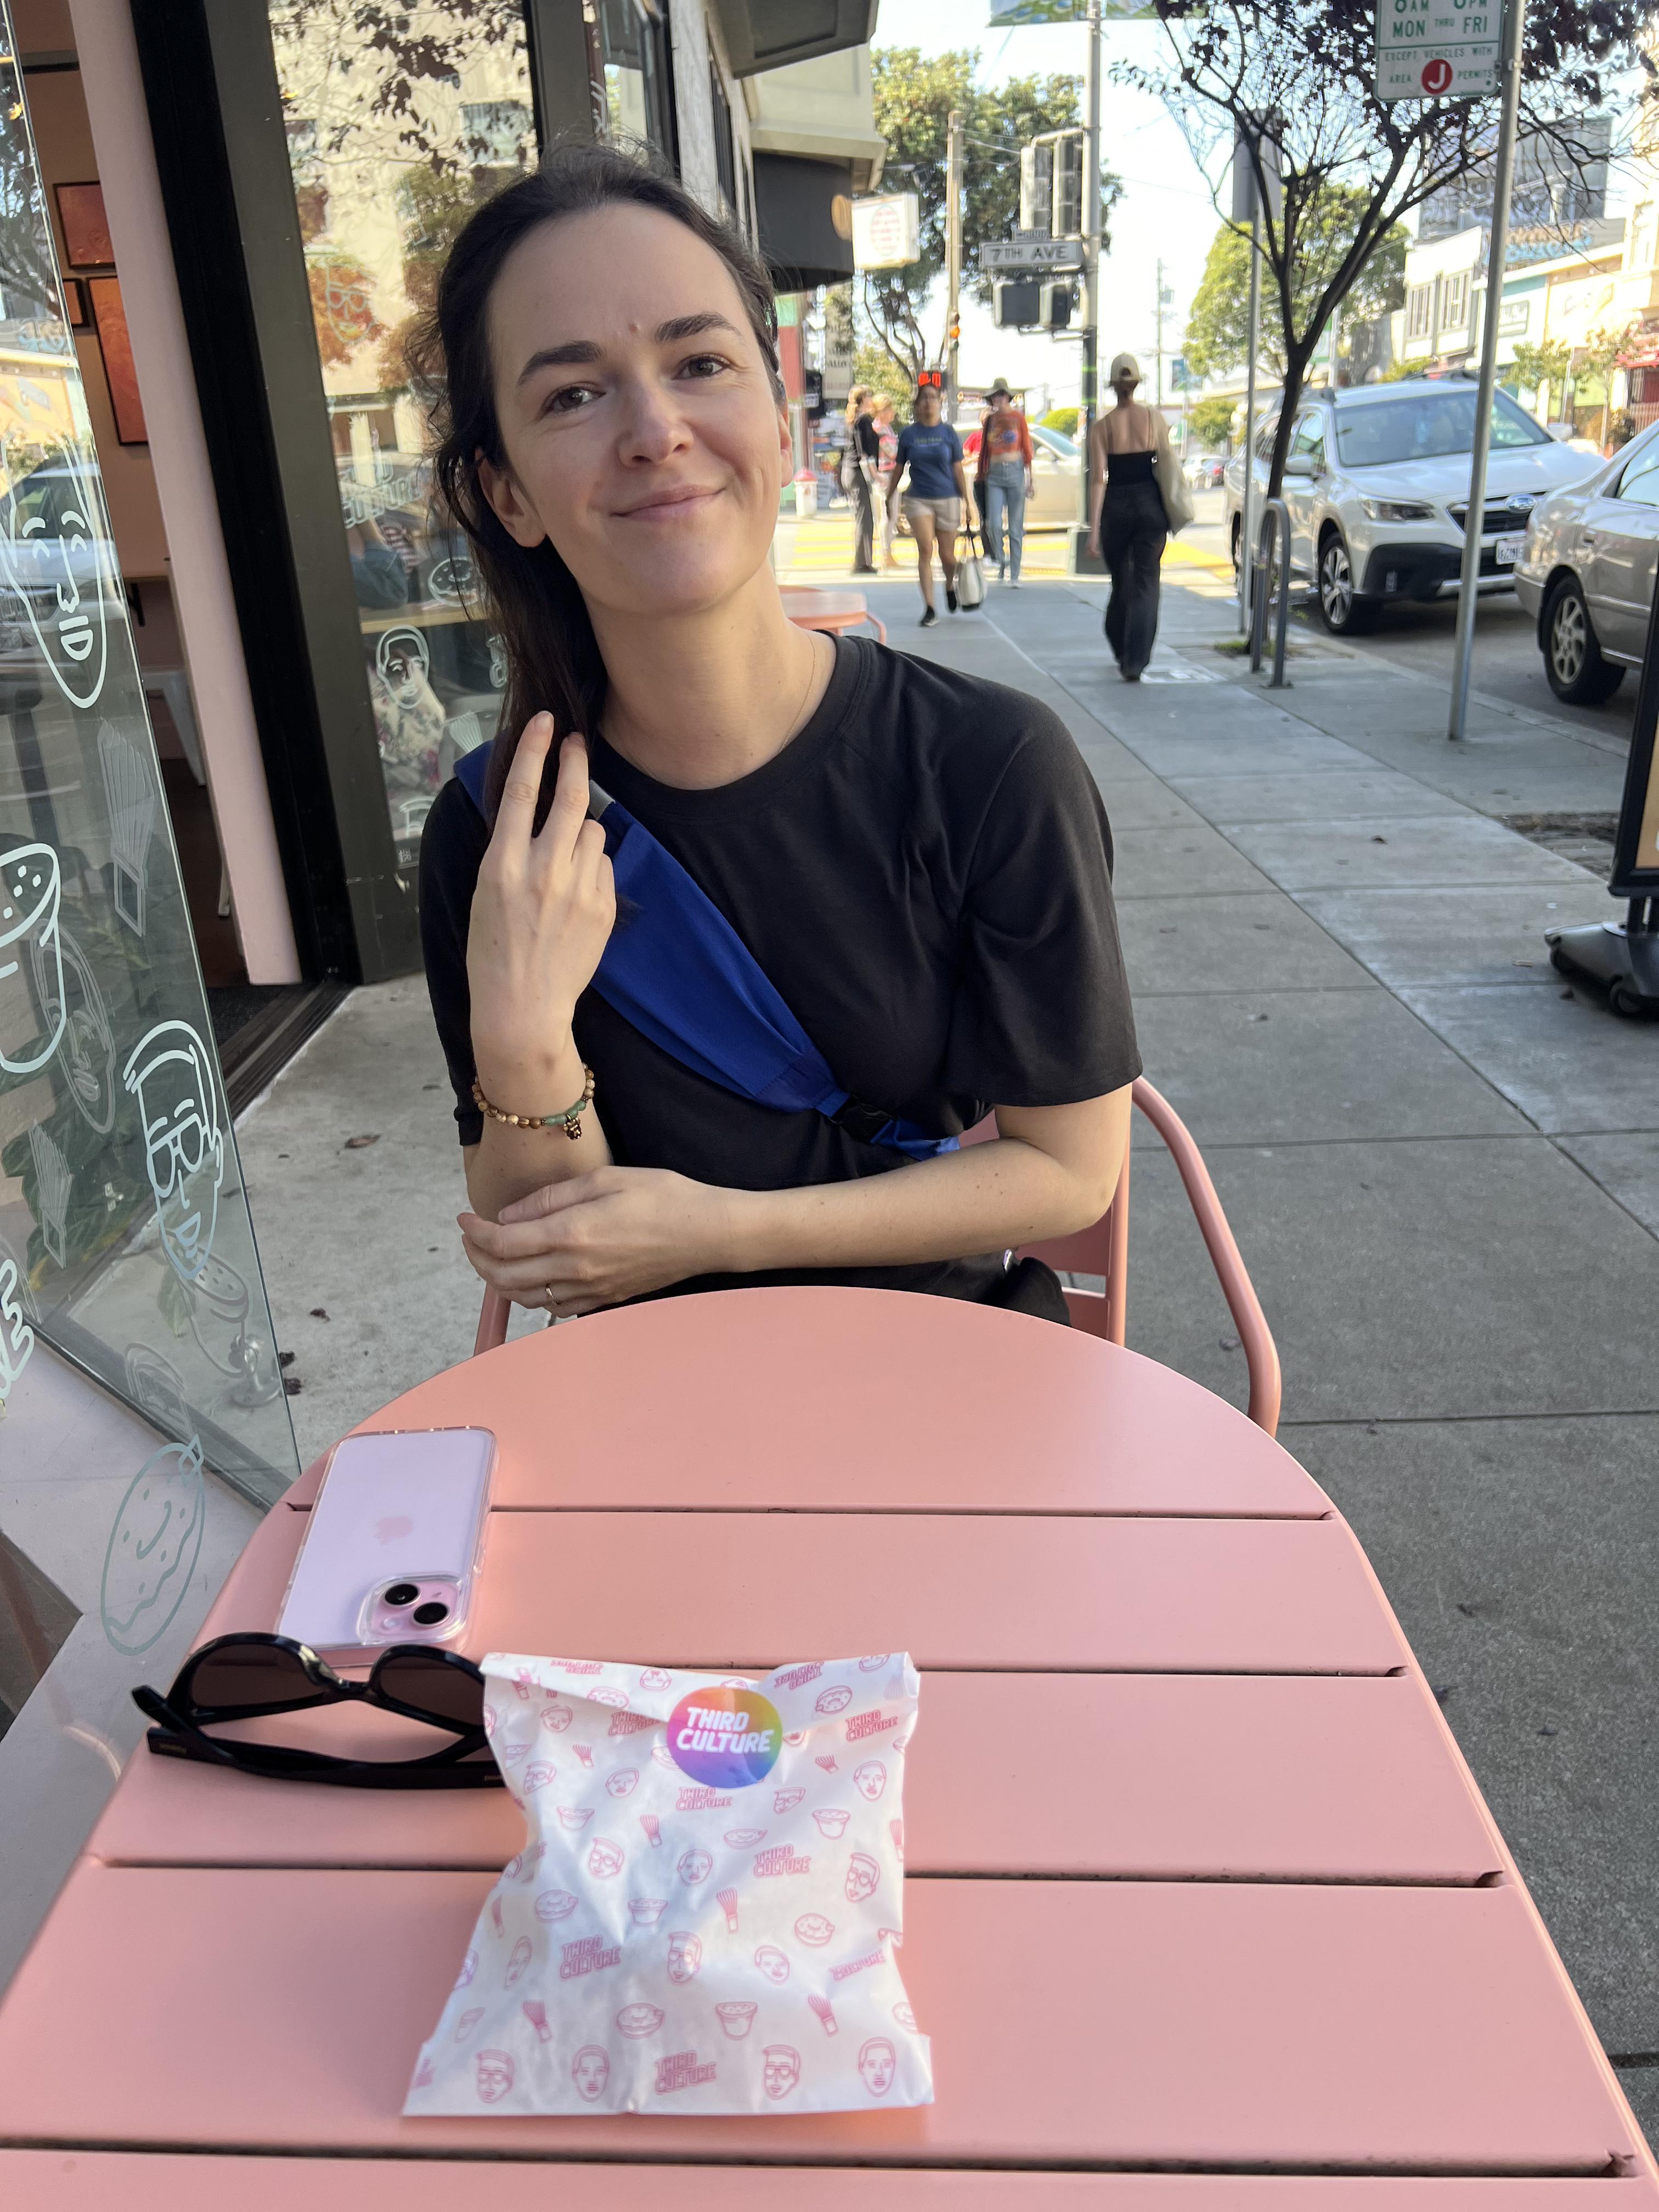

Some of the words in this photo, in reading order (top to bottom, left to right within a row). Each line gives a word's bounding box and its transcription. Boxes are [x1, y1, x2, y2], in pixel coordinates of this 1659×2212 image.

[1392, 20, 1426, 38] MON
[1435, 18, 1455, 27] THRU
[1463, 16, 1488, 33] FRI
[1385, 50, 1418, 61] EXCEPT
[1424, 48, 1465, 59] VEHICLES
[1471, 47, 1492, 55] WITH
[1390, 74, 1412, 83] AREA
[1427, 64, 1446, 89] J
[1457, 69, 1493, 80] PERMITS
[991, 247, 1023, 262] 7TH
[1030, 245, 1067, 259] AVE
[687, 1706, 749, 1732] THIRD
[845, 1709, 881, 1729] THIRD
[847, 1716, 898, 1741] CULTURE
[676, 1728, 774, 1754] CULTURE
[676, 1796, 732, 1811] CULTURE
[679, 1786, 715, 1798] THIRD
[755, 1844, 793, 1864] THIRD
[754, 1856, 811, 1877] CULTURE
[562, 1934, 602, 1962] THIRD
[560, 1946, 621, 1979] CULTURE
[654, 2050, 697, 2076] THIRD
[654, 2062, 716, 2095] CULTURE
